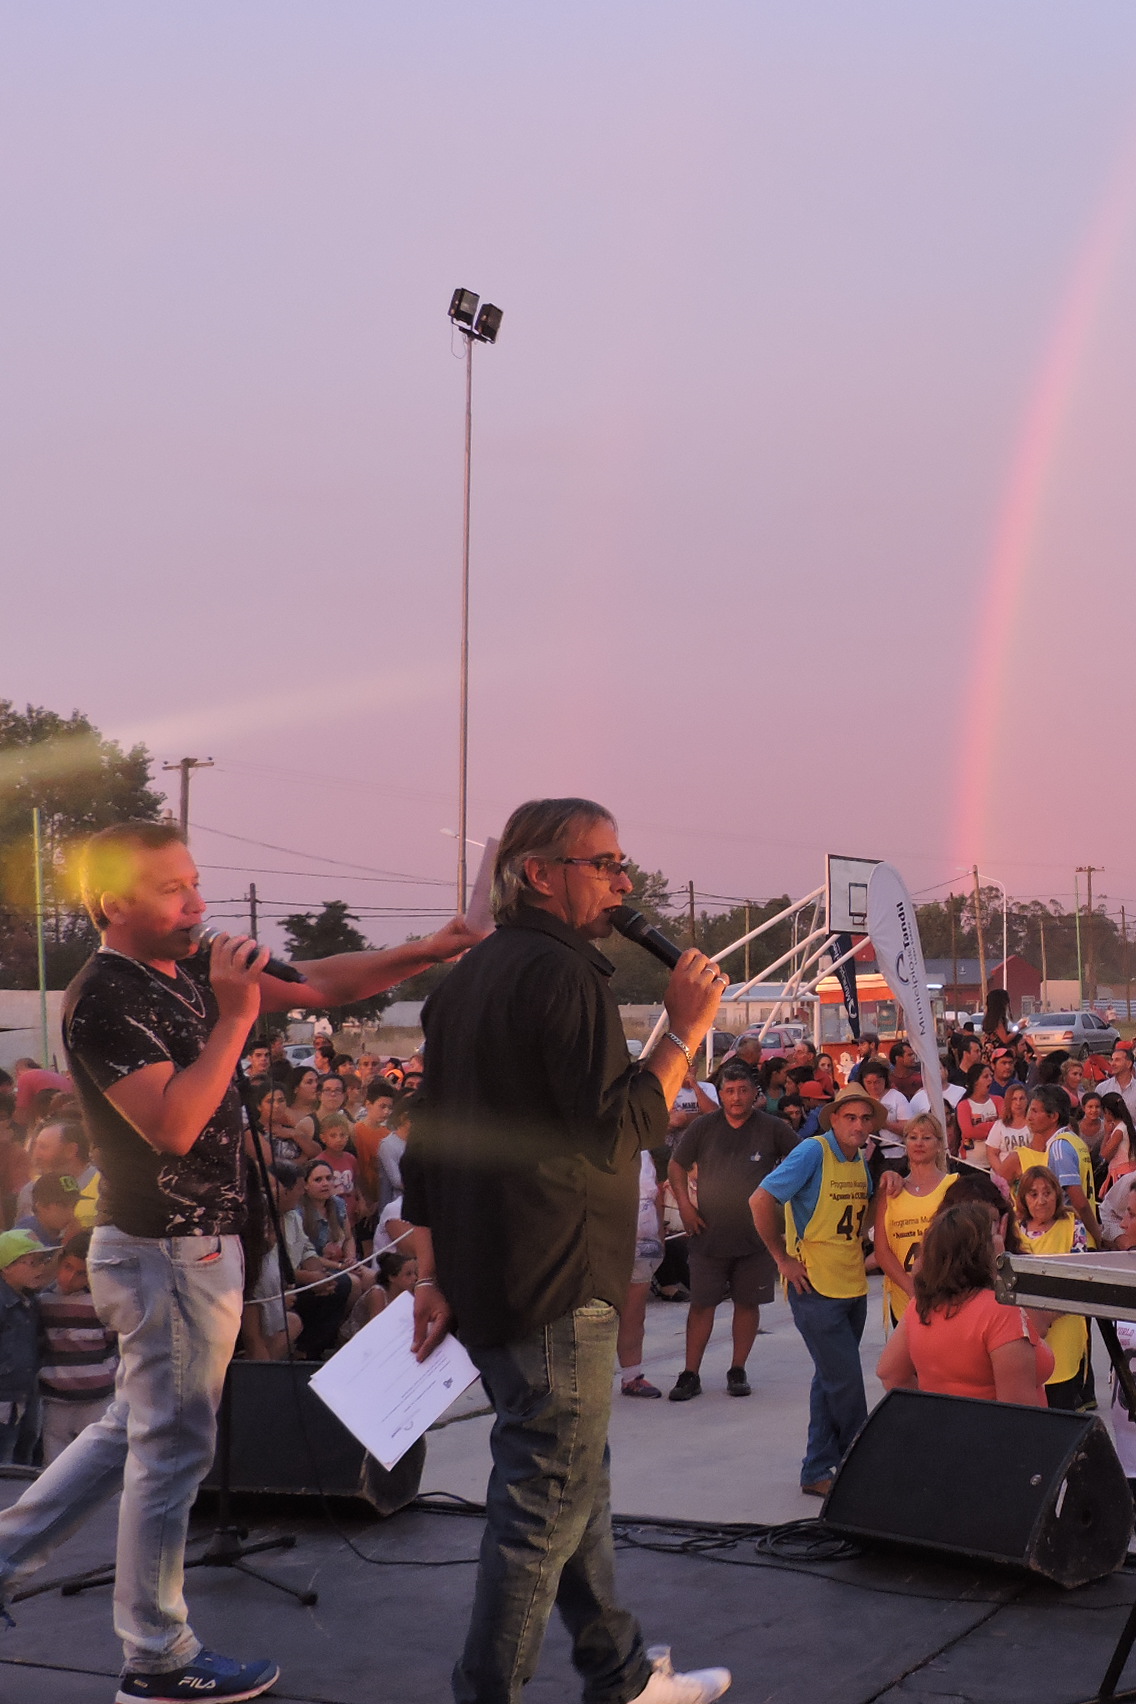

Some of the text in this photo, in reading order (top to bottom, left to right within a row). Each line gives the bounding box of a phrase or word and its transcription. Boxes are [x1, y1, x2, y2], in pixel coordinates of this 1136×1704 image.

[895, 901, 911, 951] Tandil
[908, 961, 926, 1036] Municipio
[837, 1205, 866, 1241] 41
[904, 1242, 921, 1273] 4
[178, 1676, 217, 1689] FILA
